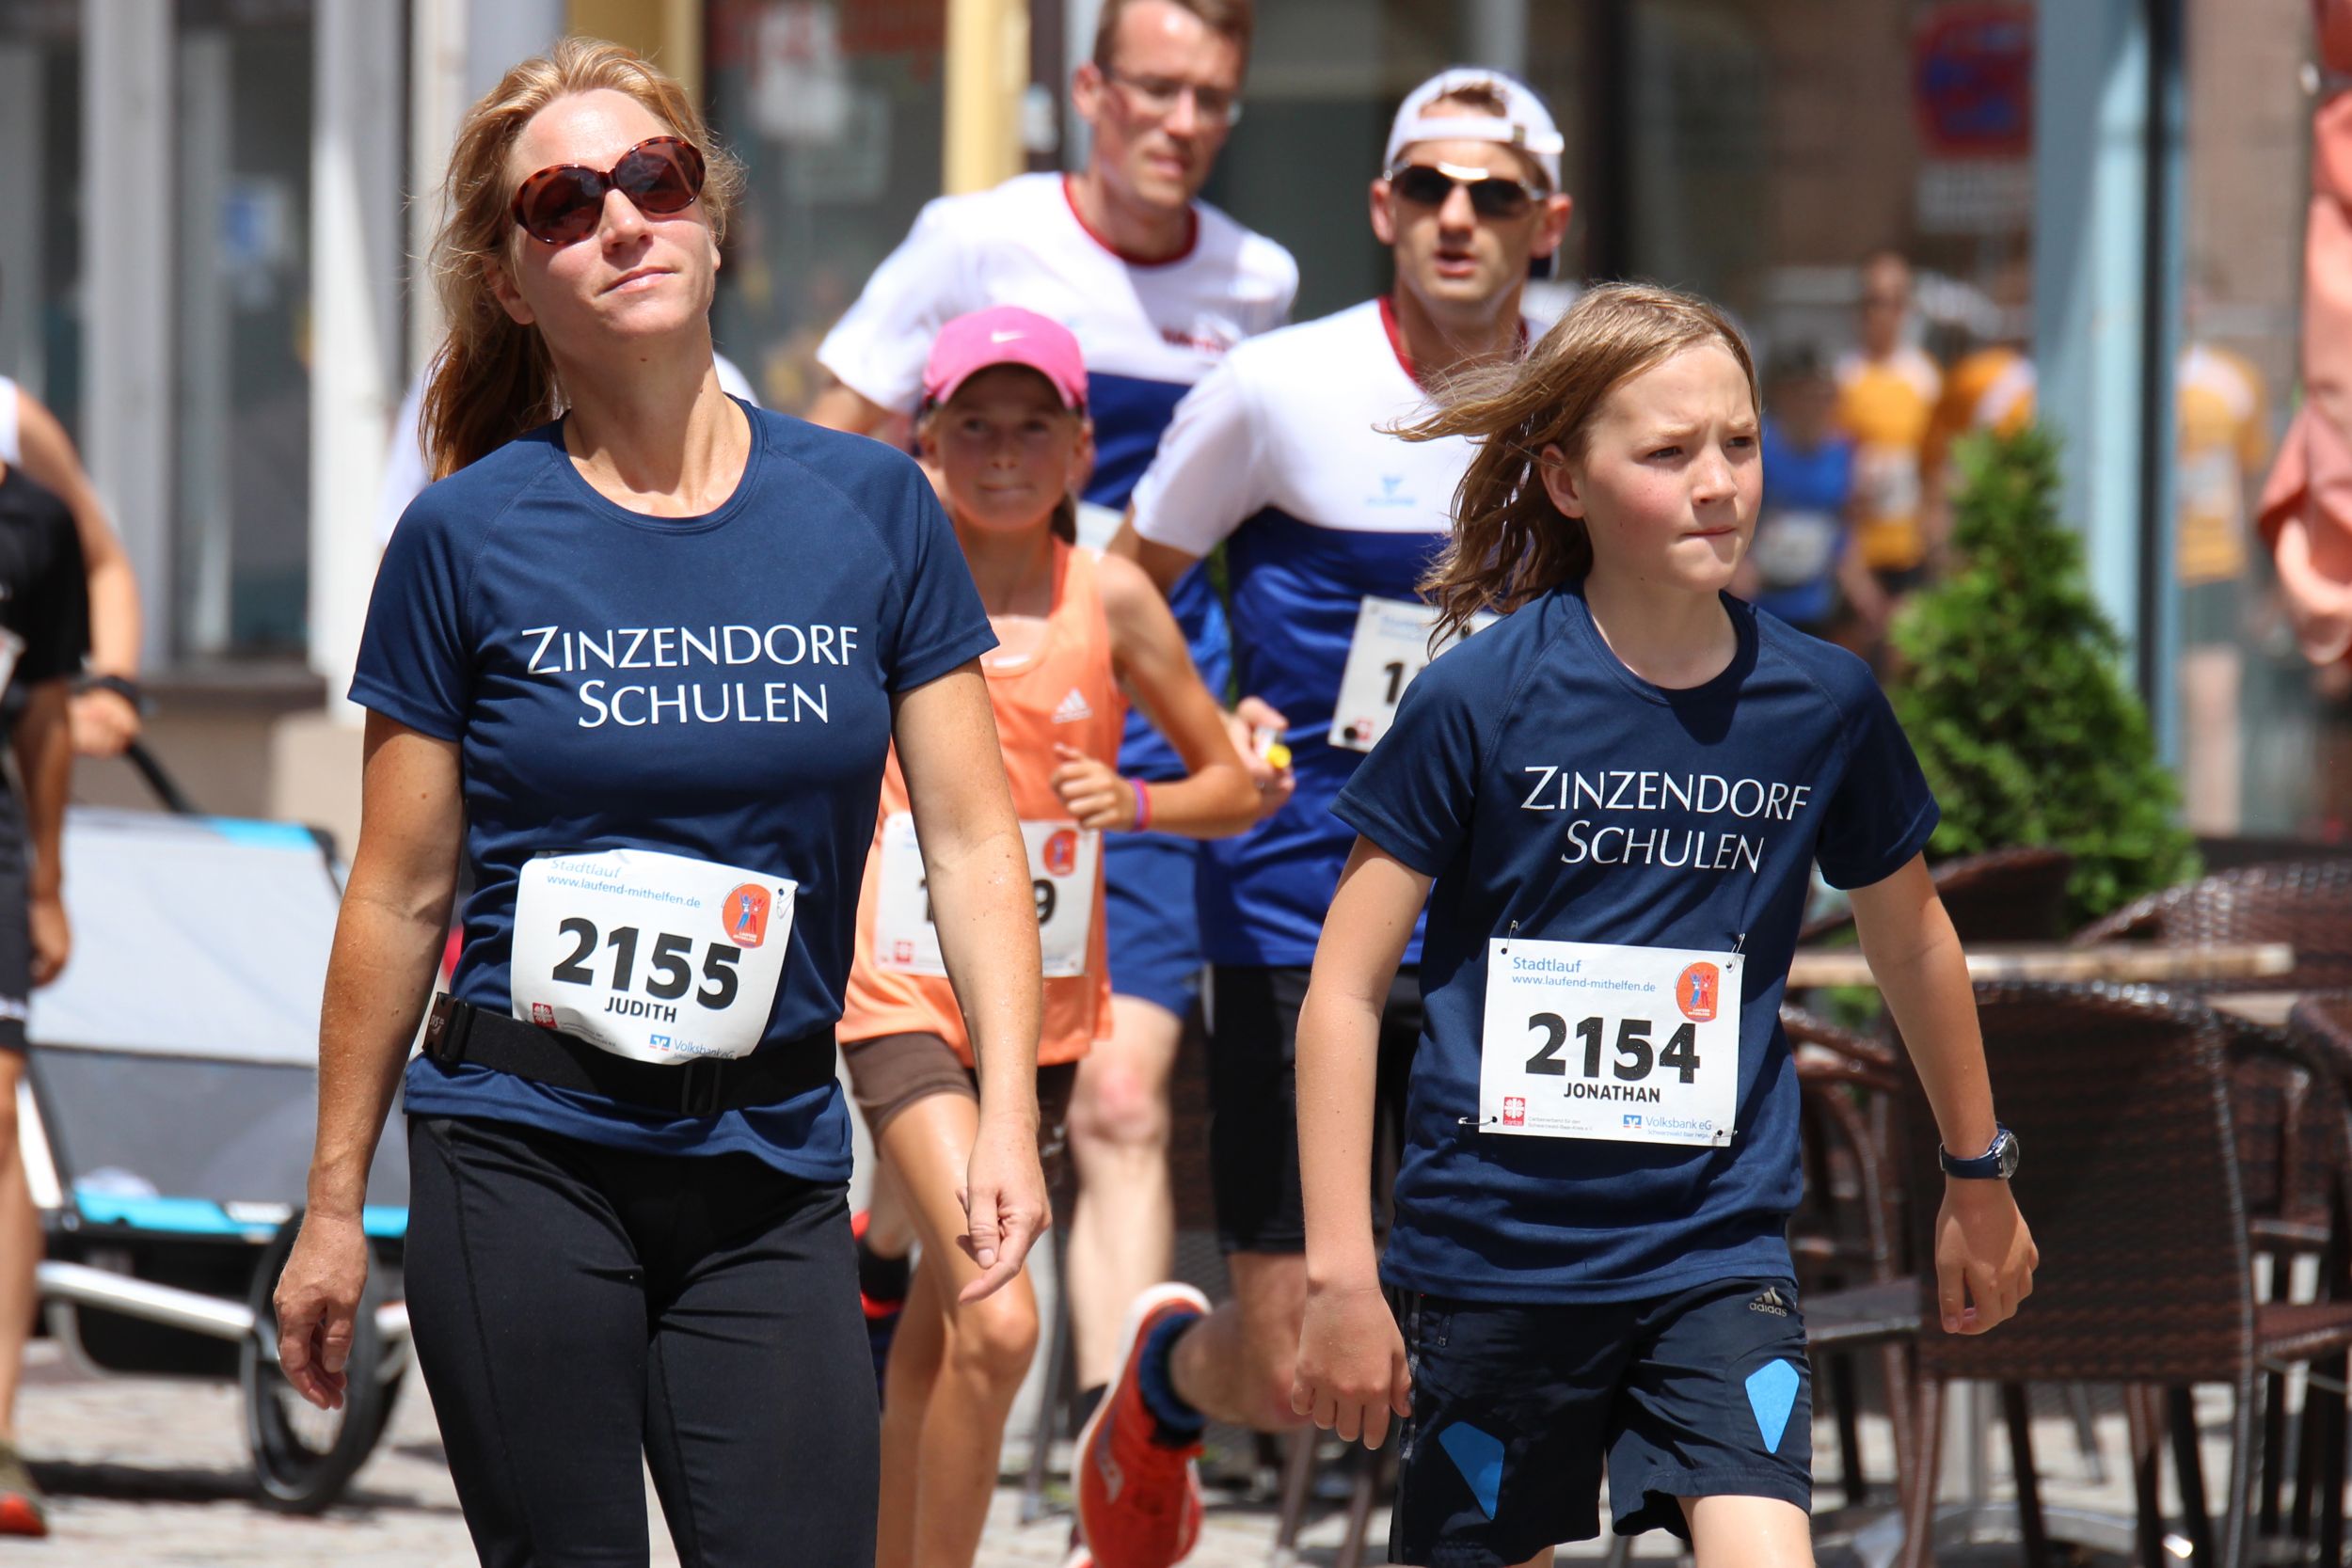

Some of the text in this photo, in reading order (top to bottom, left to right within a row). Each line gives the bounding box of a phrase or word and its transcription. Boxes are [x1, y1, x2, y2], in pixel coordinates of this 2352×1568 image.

[521, 625, 858, 674] ZINZENDORF
[578, 679, 829, 728] SCHULEN
[1520, 766, 1811, 821] ZINZENDORF
[1560, 819, 1765, 874] SCHULEN
[550, 858, 622, 879] Stadtlauf
[547, 874, 702, 909] www.laufend-mithelfen.de
[551, 916, 742, 1011] 2155
[1513, 956, 1581, 974] Stadtlauf
[1512, 974, 1657, 992] www.laufend-mithelfen.de
[604, 995, 677, 1023] JUDITH
[1525, 1012, 1701, 1085] 2154
[1563, 1082, 1661, 1103] JONATHAN
[1645, 1116, 1712, 1131] Volksbank eG
[1749, 1302, 1788, 1317] adidas
